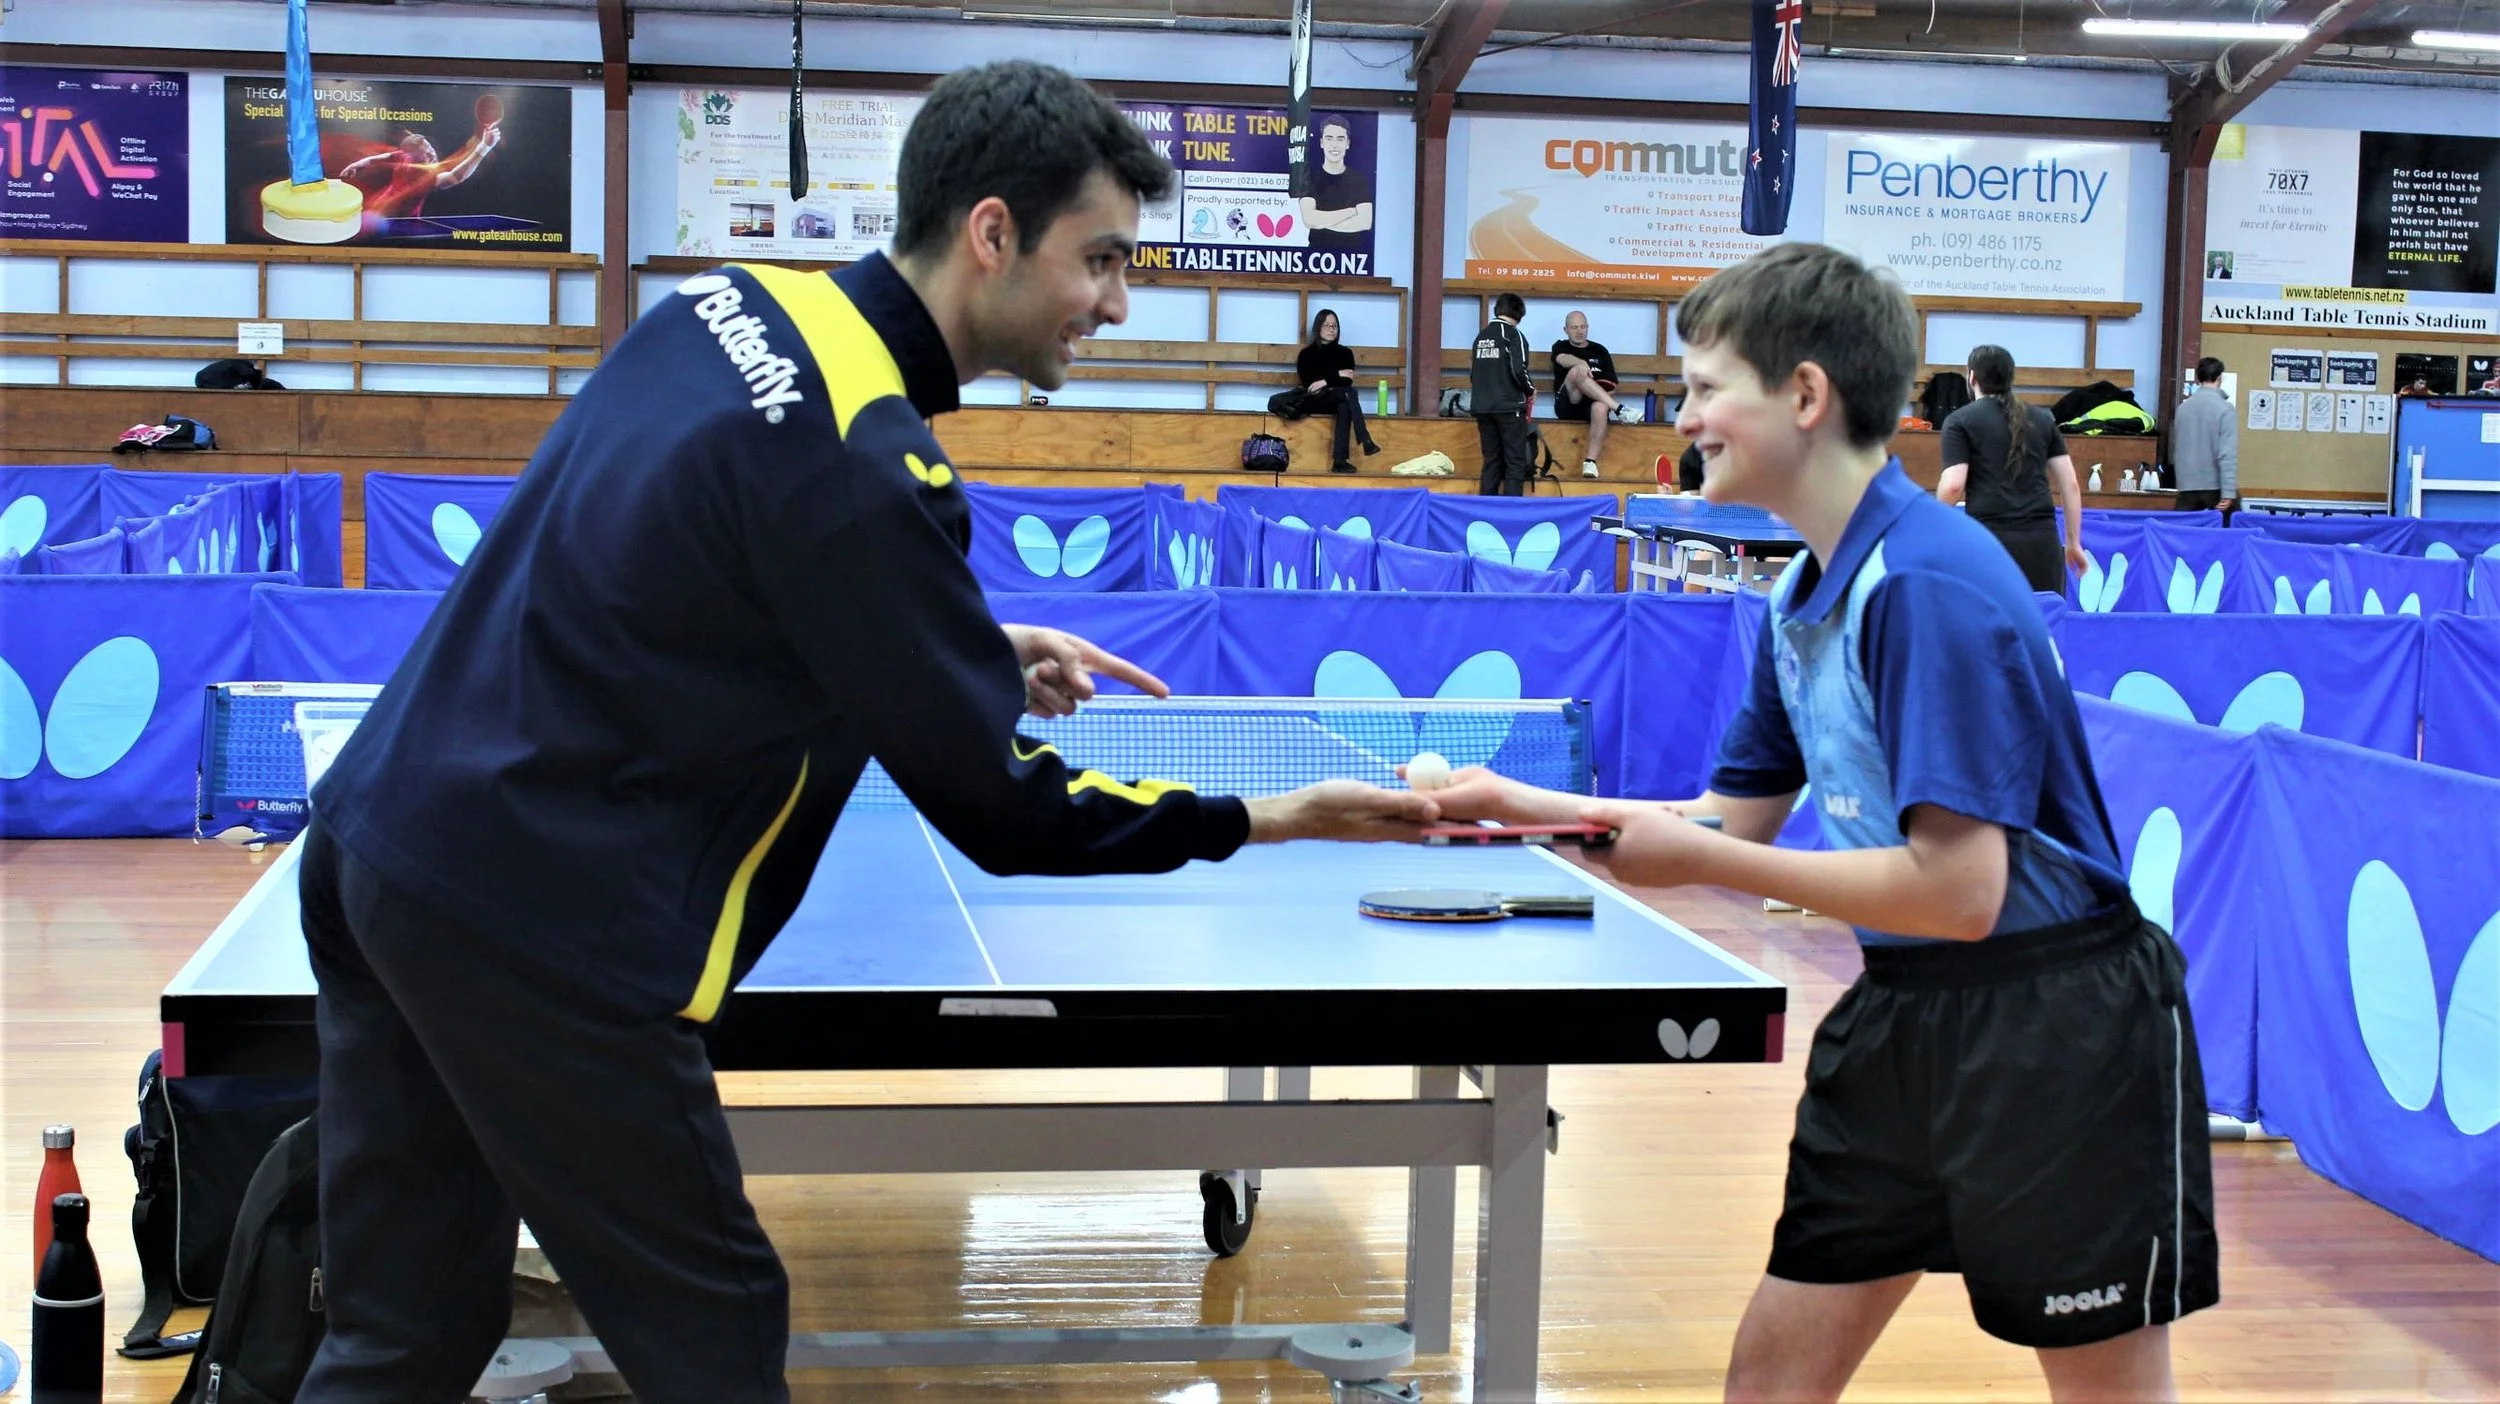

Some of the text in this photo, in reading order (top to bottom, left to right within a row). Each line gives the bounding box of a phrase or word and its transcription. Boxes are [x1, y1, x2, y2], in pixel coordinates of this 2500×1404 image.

[822, 99, 898, 112] FREE TRIAL
[244, 104, 284, 117] Special
[320, 107, 336, 119] for
[338, 107, 377, 122] Special
[380, 108, 433, 122] Occasions
[706, 115, 732, 125] DDS
[778, 111, 811, 124] DS
[815, 112, 876, 126] Meridian
[1183, 112, 1237, 134] TABLE
[120, 137, 147, 145] Offline
[120, 146, 146, 154] Digital
[1182, 140, 1235, 162] TUNE.
[120, 154, 159, 163] Activation
[1188, 174, 1204, 183] Call
[1206, 175, 1234, 188] Dinyar:
[1237, 176, 1258, 187] (021)
[1260, 177, 1274, 186] 146
[2392, 168, 2480, 181] For God so loved
[8, 181, 32, 189] Social
[112, 183, 136, 192] Alipay
[1846, 149, 2109, 224] Penberthy
[2392, 180, 2482, 193] the world that he
[8, 189, 55, 199] Engagement
[112, 191, 158, 200] WeChat Pay
[1658, 190, 1714, 203] Transport
[2391, 193, 2479, 205] gave his one and
[1187, 194, 1289, 210] Proudly supported by:
[1613, 203, 1651, 216] Traffic
[1656, 206, 1695, 219] Impact
[1845, 204, 2078, 224] INSURANCE & MORTGAGE BROKERS
[2276, 204, 2300, 215] time
[2391, 204, 2414, 216] only
[2441, 206, 2463, 216] that
[1149, 210, 1174, 224] Shop
[2390, 215, 2480, 229] whoever believes
[1656, 221, 1694, 233] Traffic
[2240, 218, 2330, 234] invest for Eternity
[452, 229, 563, 244] www.gateauhouse.com
[2389, 227, 2469, 240] in him shall not
[1617, 236, 1764, 252] Commercial & Residential
[1910, 231, 2043, 252] ph. (09) 486 1175
[2388, 240, 2469, 252] perish but have
[1631, 247, 1705, 261] Development
[2387, 251, 2463, 264] ETERNAL LIFE.
[1887, 251, 2063, 274] www.penberthy.co.nz
[1477, 267, 1492, 276] Tel.
[1496, 267, 1508, 277] 09
[1511, 267, 1529, 277] 869
[1532, 268, 1556, 278] 2825
[1566, 269, 1660, 282] info@commute.kiwi
[1913, 280, 1925, 291] of
[1926, 280, 1943, 291] the
[1945, 281, 1990, 293] Auckland
[1992, 282, 2018, 294] Table
[2020, 283, 2049, 295] Tennis
[2051, 284, 2107, 297] Association
[2285, 286, 2405, 304] www.tabletennis.net.nz
[2208, 304, 2488, 332] Auckland Table Tennis Stadium
[693, 285, 805, 410] Butterfly
[257, 799, 304, 814] Butterfly
[2044, 1284, 2123, 1316] JOOLA
